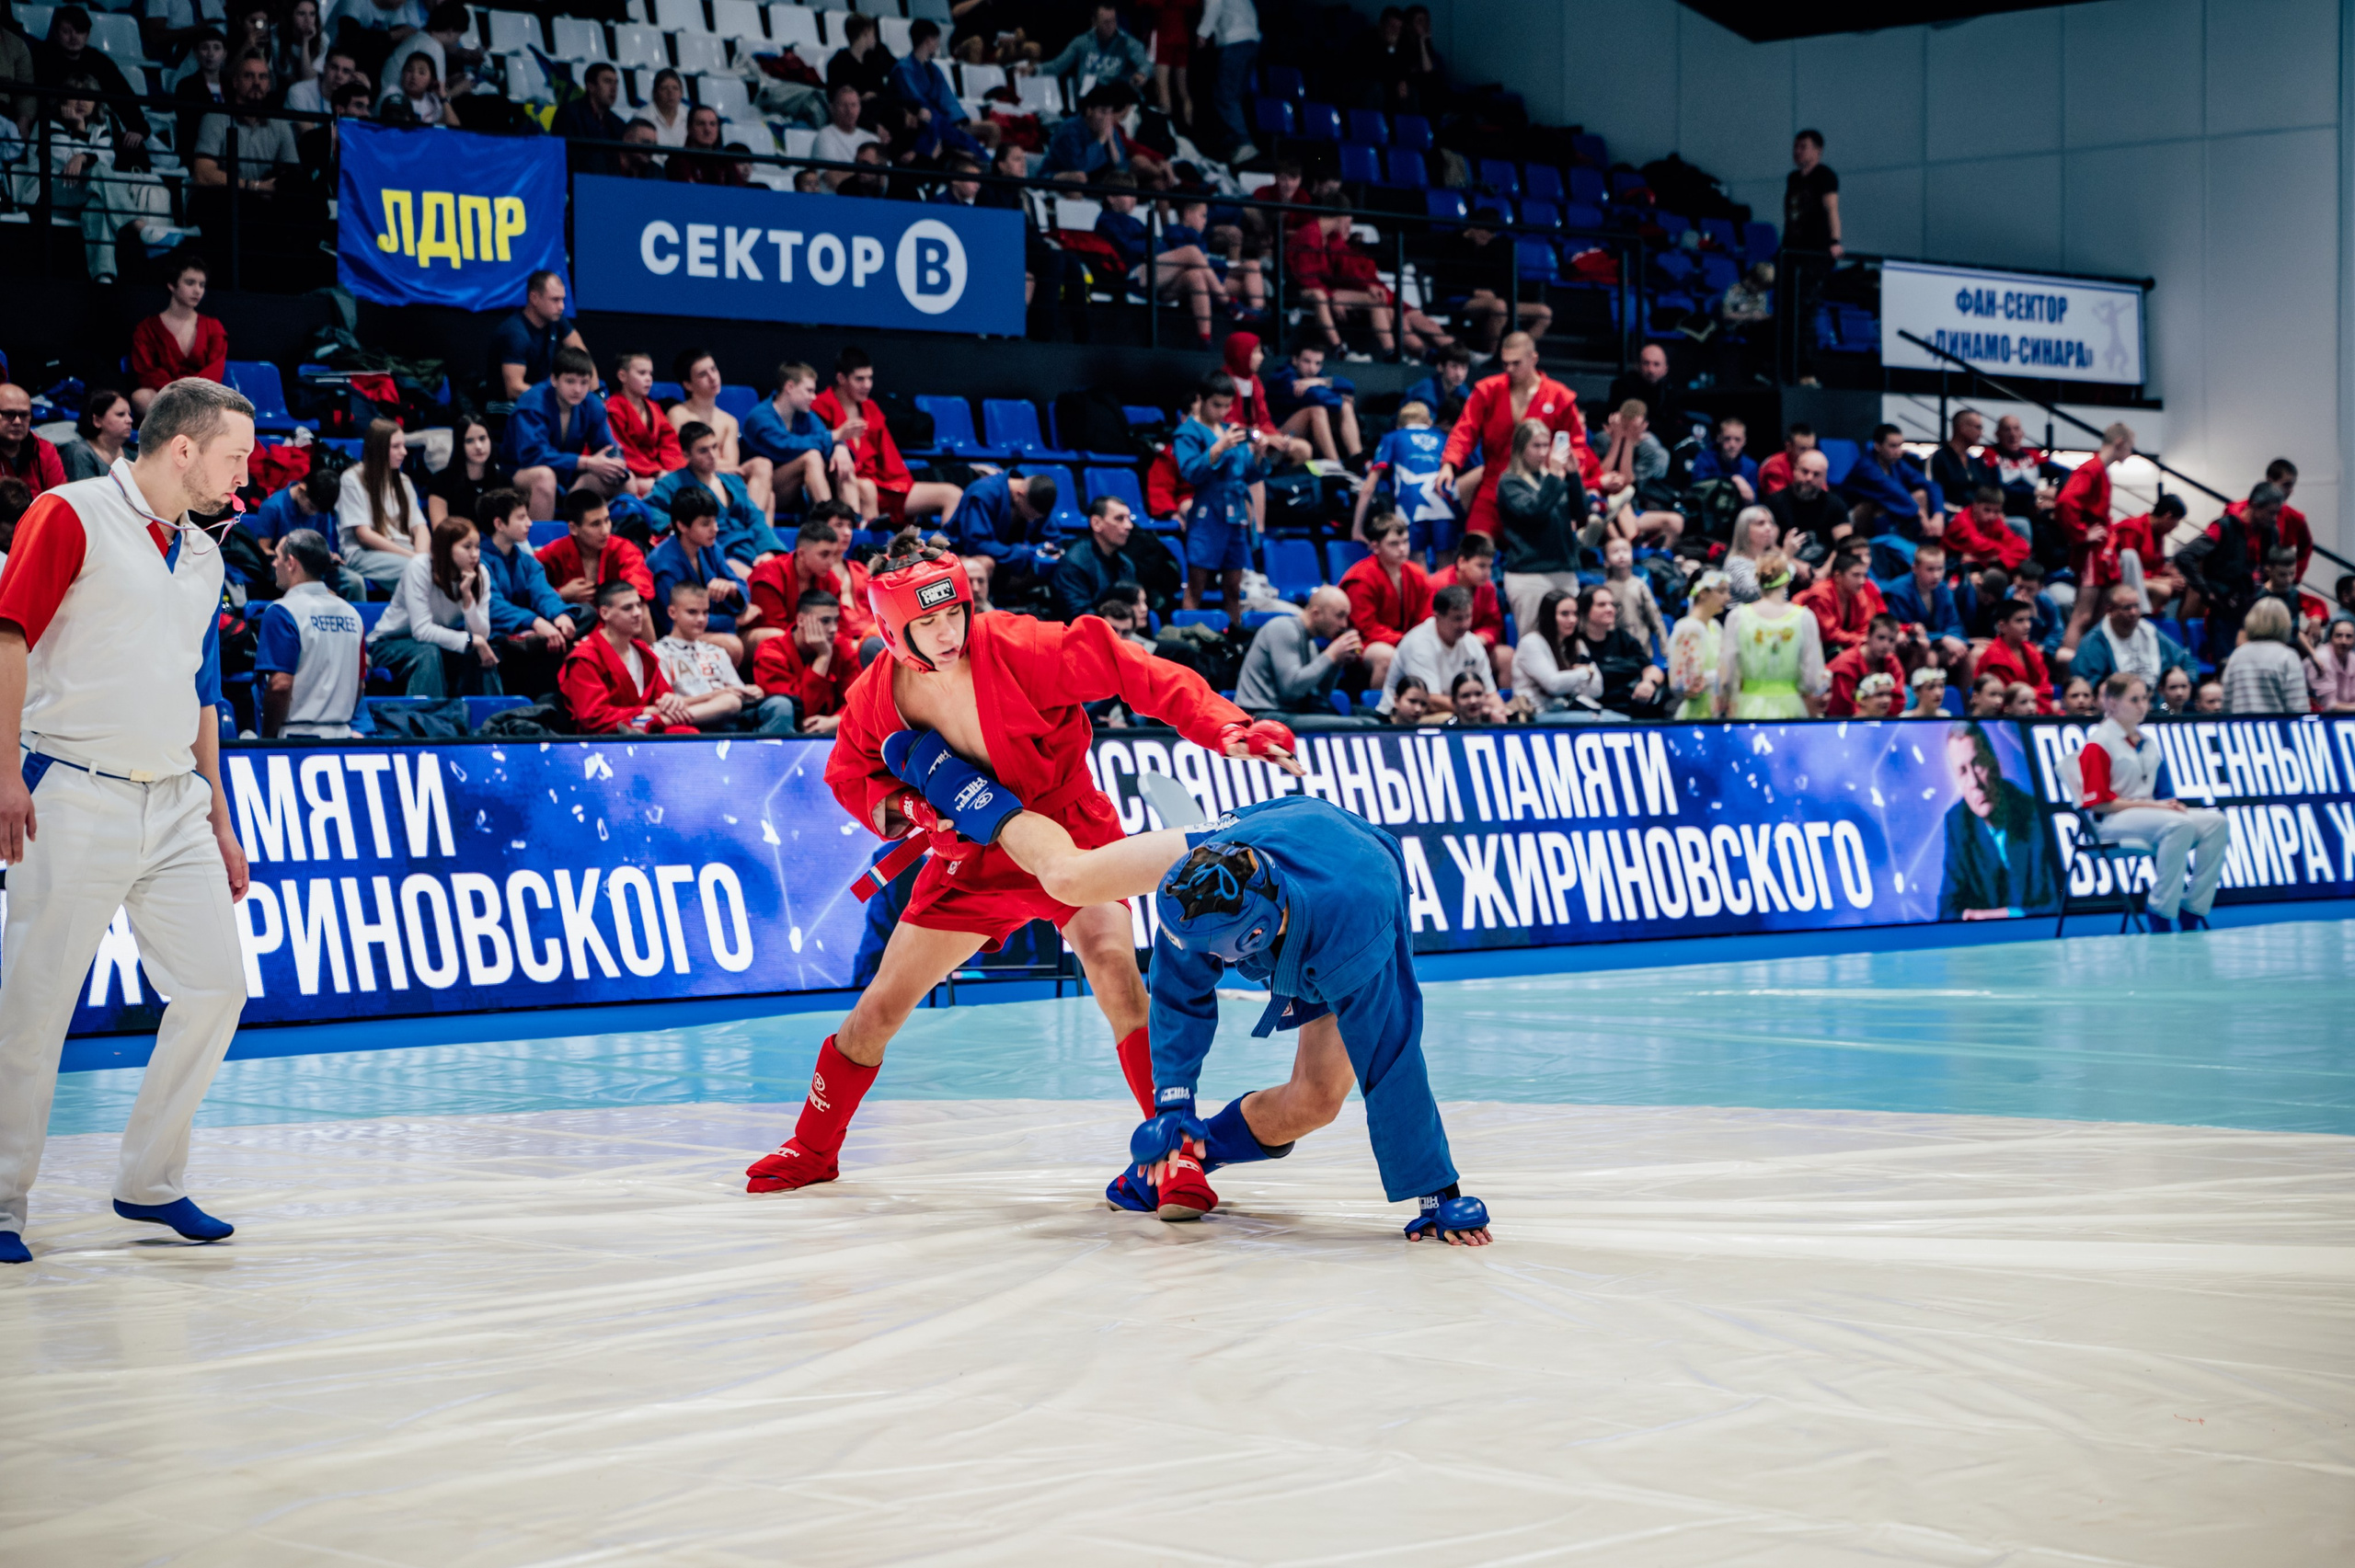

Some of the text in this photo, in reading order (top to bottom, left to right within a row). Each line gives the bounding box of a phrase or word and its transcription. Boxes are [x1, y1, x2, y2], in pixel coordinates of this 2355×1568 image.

[377, 188, 526, 269] ЛДПР
[640, 219, 952, 295] СЕКТОР В
[1956, 287, 2068, 324] ФАН-СЕКТОР
[310, 614, 358, 634] REFEREE
[1086, 728, 1680, 834] СВЯЩННЫЙ ПАМЯТИ
[2031, 715, 2342, 806] ПЩЕННЫЙ
[227, 750, 457, 863] МЯТИ
[1442, 819, 1874, 930] ЖИРИНОВСКОГО
[87, 862, 753, 1007] РИНОВСКОГО
